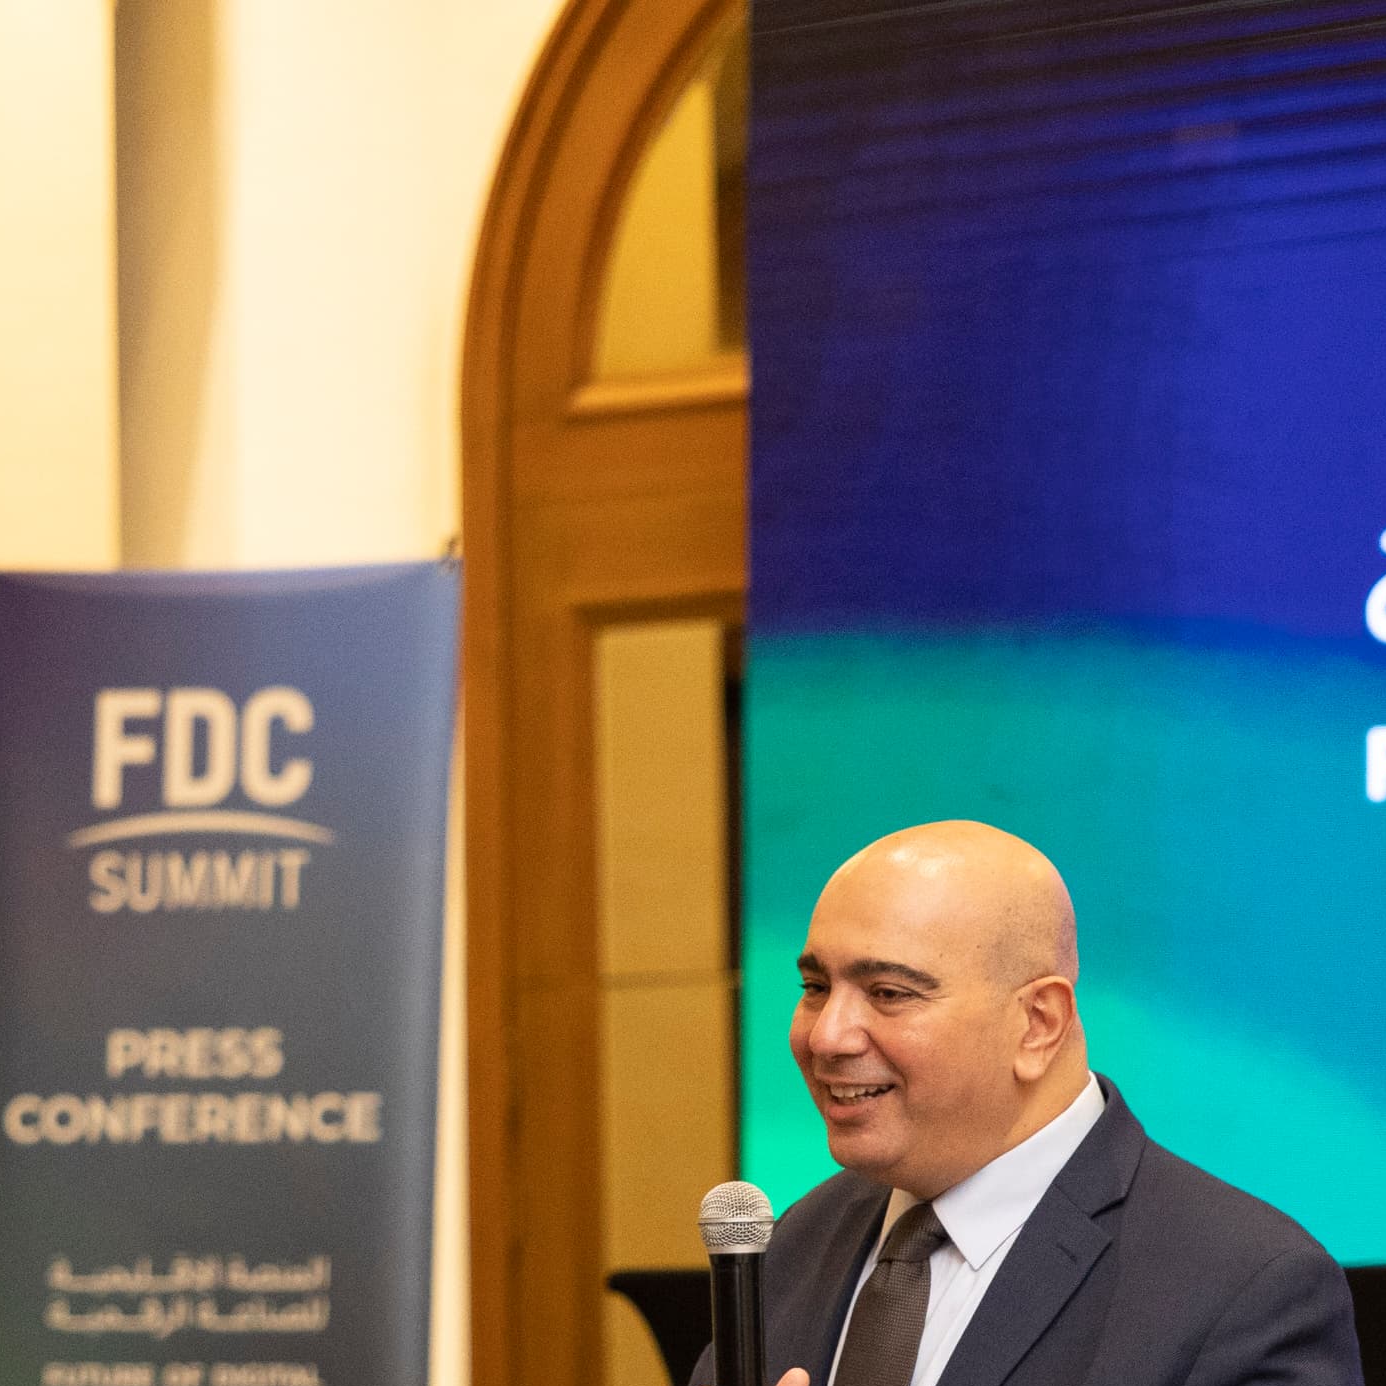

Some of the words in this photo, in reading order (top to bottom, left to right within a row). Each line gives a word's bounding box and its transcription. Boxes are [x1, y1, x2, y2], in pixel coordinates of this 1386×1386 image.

[92, 686, 315, 809] FDC
[90, 850, 307, 912] SUMMIT
[107, 1028, 283, 1078] PRESS
[4, 1094, 382, 1144] CONFERENCE
